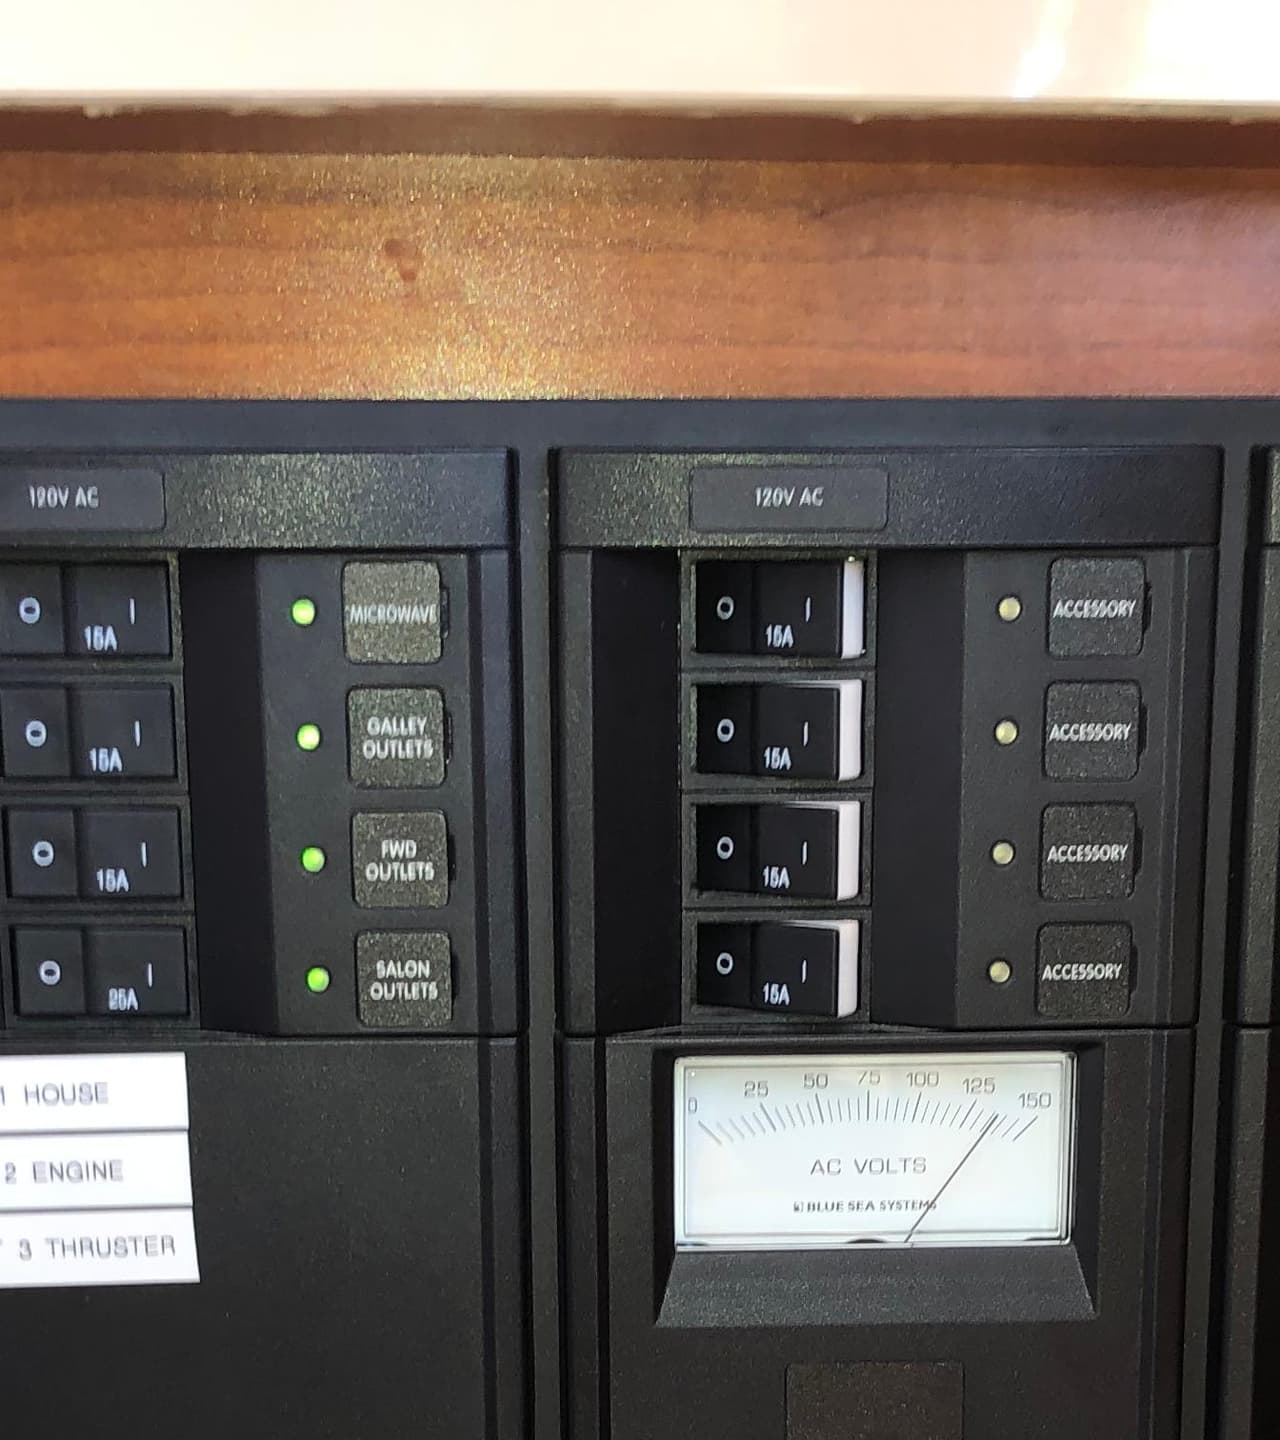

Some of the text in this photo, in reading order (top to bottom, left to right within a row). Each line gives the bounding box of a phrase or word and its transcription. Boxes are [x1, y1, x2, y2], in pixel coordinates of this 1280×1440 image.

[76, 487, 98, 507] AC
[756, 487, 823, 506] 120V AC
[349, 604, 438, 626] MICROWAVE
[1053, 599, 1136, 620] ACCESSORY
[367, 717, 426, 739] GALLEY
[1049, 722, 1132, 743] ACCESSORY
[363, 739, 433, 760] OUTLETS
[381, 840, 416, 861] FWD
[1047, 843, 1128, 863] ACCESSORY
[366, 861, 434, 883] OUTLETS
[376, 960, 430, 981] SALON
[1042, 962, 1123, 982] ACCESSORY
[370, 980, 439, 1002] OUTLETS
[24, 1082, 109, 1106] HOUSE
[744, 1080, 768, 1097] 25
[804, 1073, 828, 1089] 50
[857, 1071, 880, 1085] 75
[906, 1071, 939, 1087] 100
[962, 1078, 996, 1094] 125
[1018, 1093, 1051, 1109] 150
[4, 1162, 17, 1185] 2
[32, 1159, 124, 1184] ENGINE
[811, 1158, 927, 1175] AC VOLTS
[807, 1200, 937, 1213] BLUE SEA SYSTEMS
[19, 1238, 32, 1261] 3
[45, 1234, 177, 1258] THRUSTER
